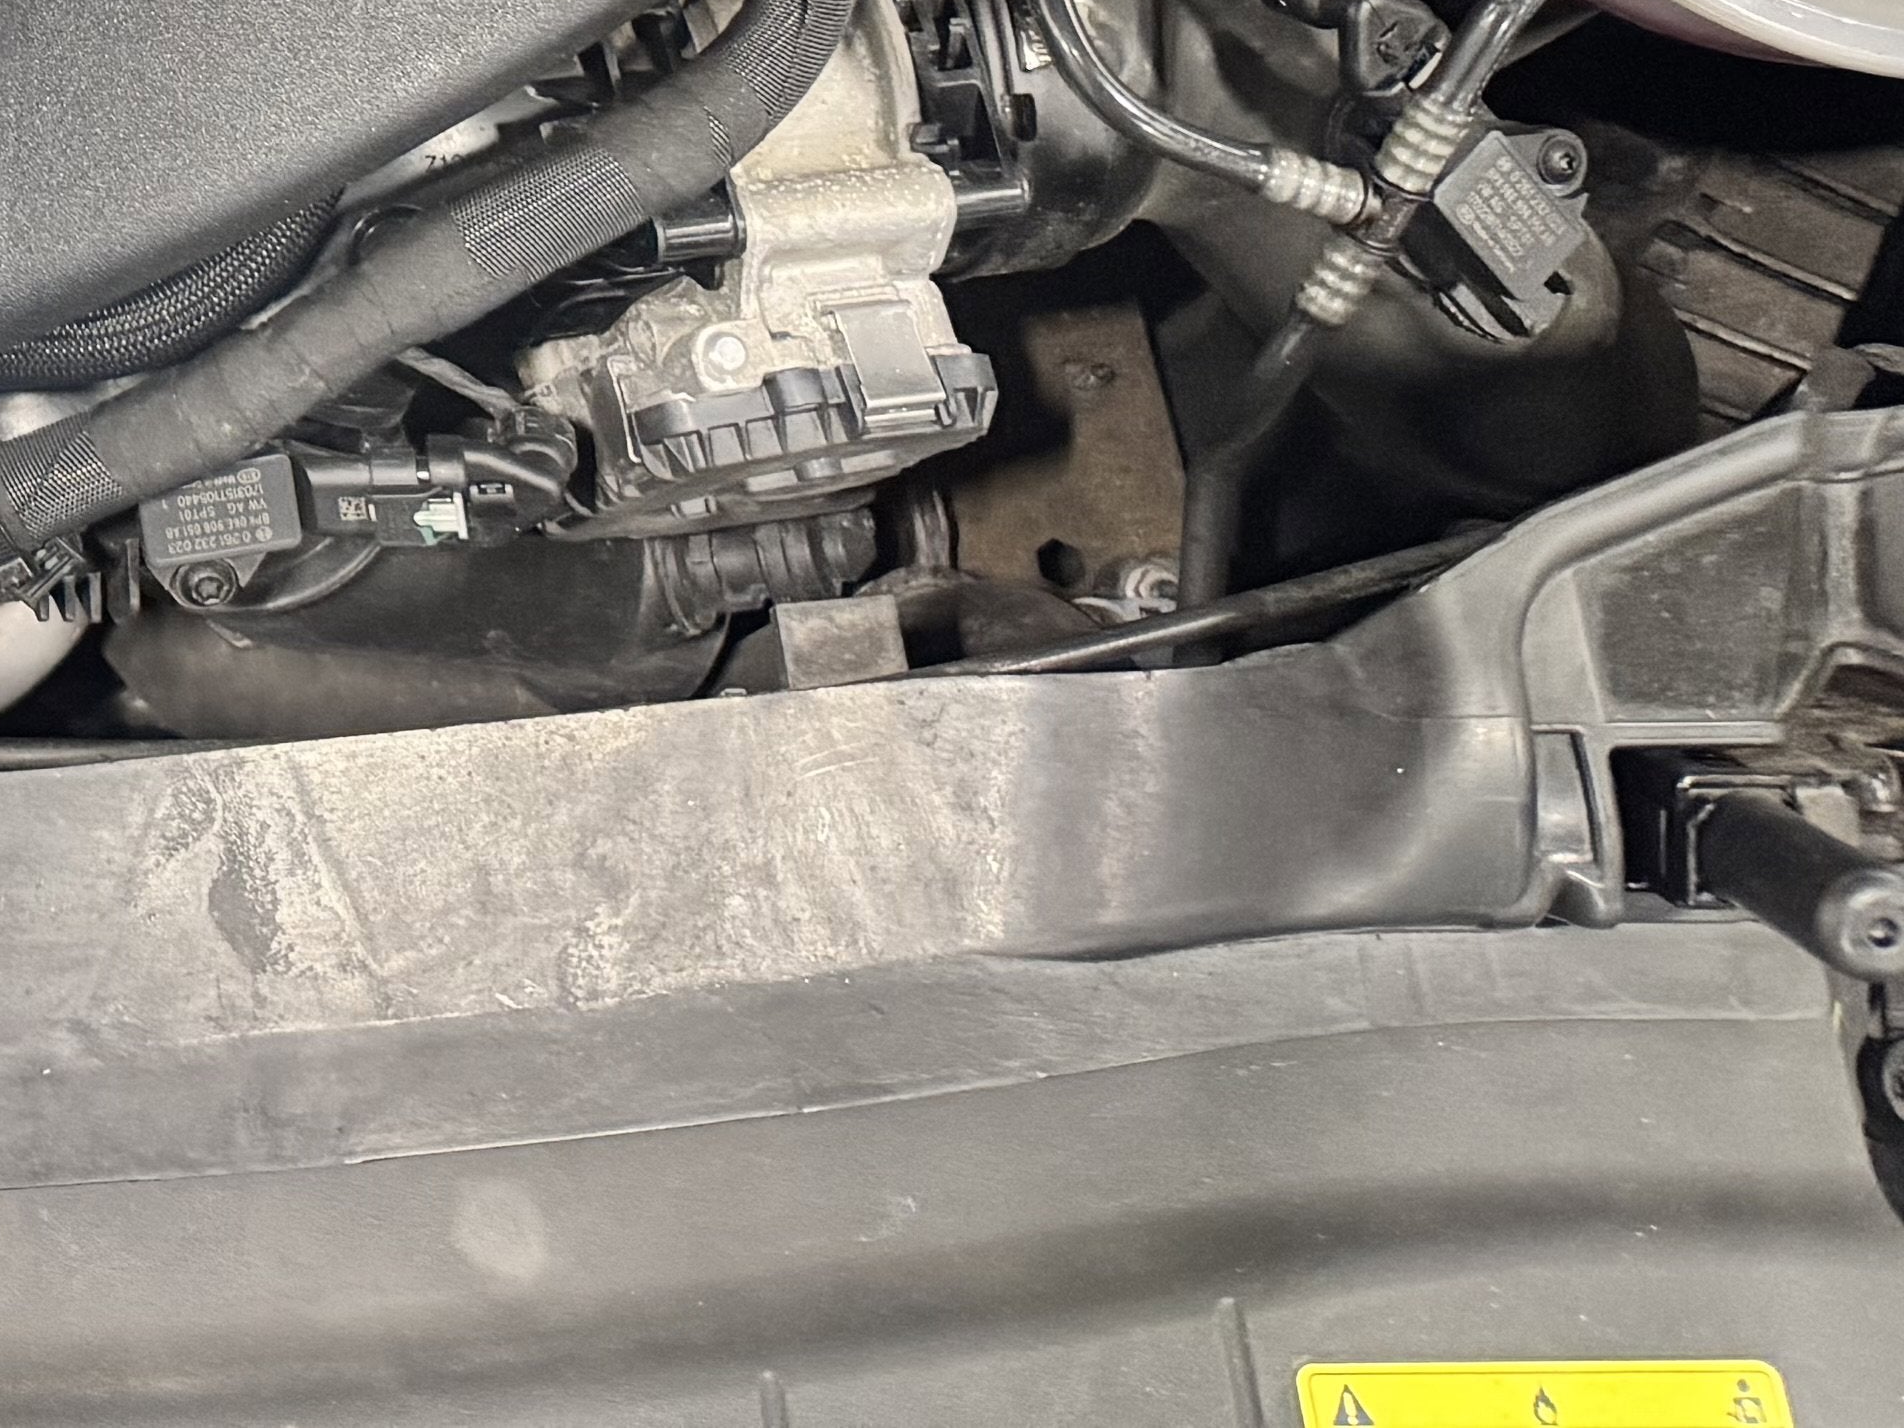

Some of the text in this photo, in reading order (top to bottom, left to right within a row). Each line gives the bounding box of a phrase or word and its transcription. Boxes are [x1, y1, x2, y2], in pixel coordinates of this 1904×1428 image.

[226, 500, 244, 514] AG
[247, 497, 267, 510] VW
[194, 535, 217, 549] 232
[241, 530, 251, 542] 0
[167, 539, 192, 554] 023
